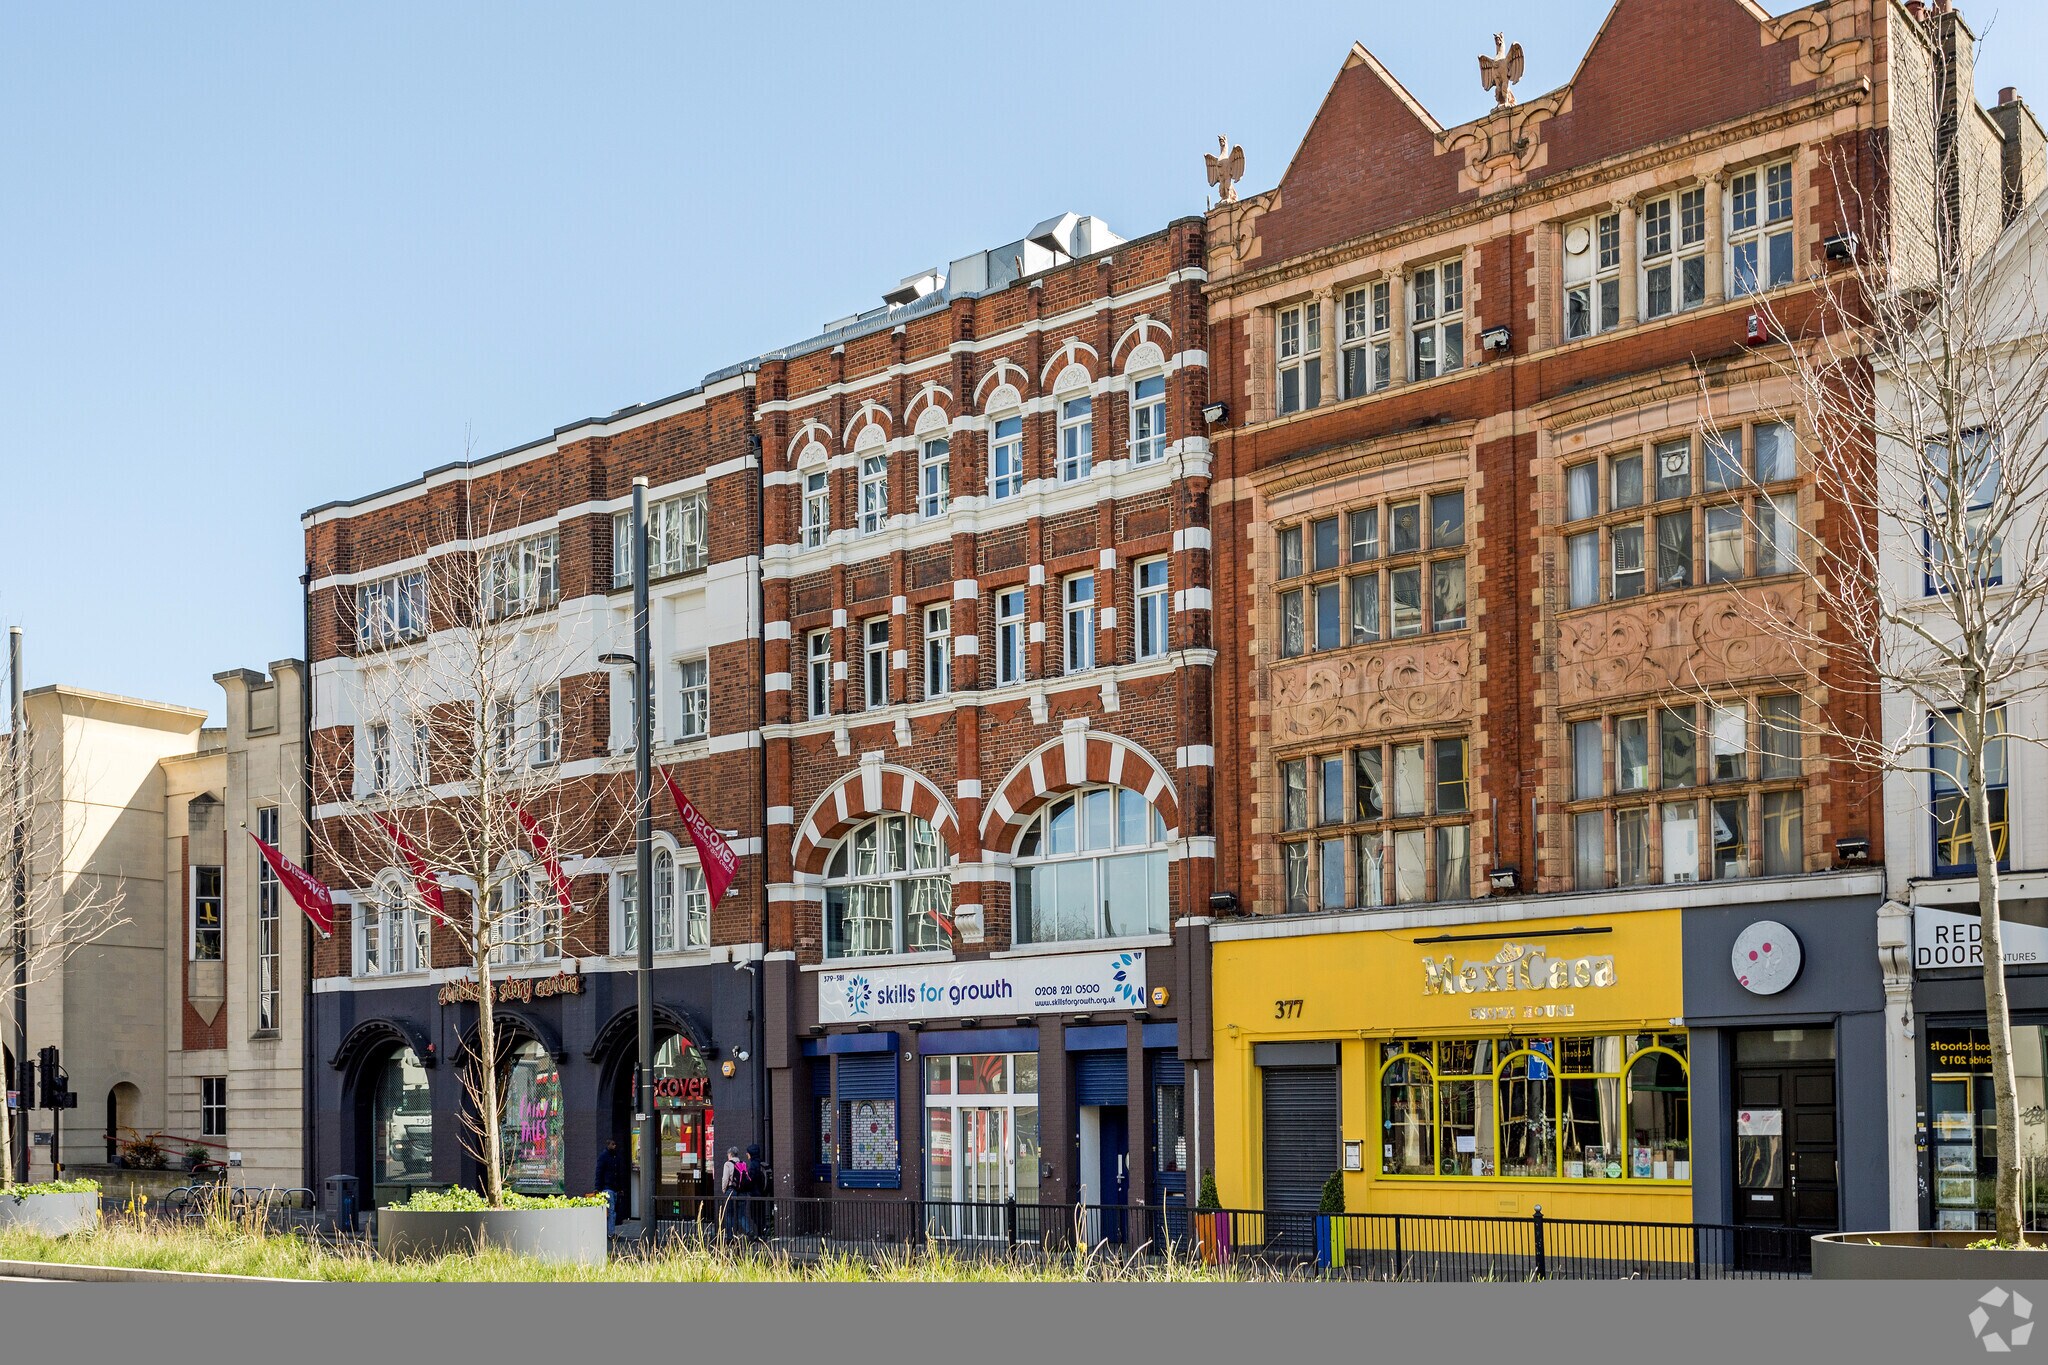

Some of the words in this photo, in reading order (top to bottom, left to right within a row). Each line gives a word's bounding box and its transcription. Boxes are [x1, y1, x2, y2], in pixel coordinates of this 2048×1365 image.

[1936, 923, 1982, 944] RED
[1918, 945, 1983, 966] DOOR
[1422, 946, 1617, 996] MexiCasa
[877, 984, 916, 1005] skills
[920, 982, 945, 1002] for
[949, 978, 1013, 1006] growth
[1034, 986, 1058, 996] 0208
[1060, 985, 1073, 995] 221
[1075, 983, 1100, 994] 0500
[1034, 996, 1116, 1008] www.skillsforgrowth.org.uk
[1274, 999, 1304, 1019] 377
[1470, 1006, 1515, 1020] ESSEX
[1523, 1003, 1575, 1018] HOUSE
